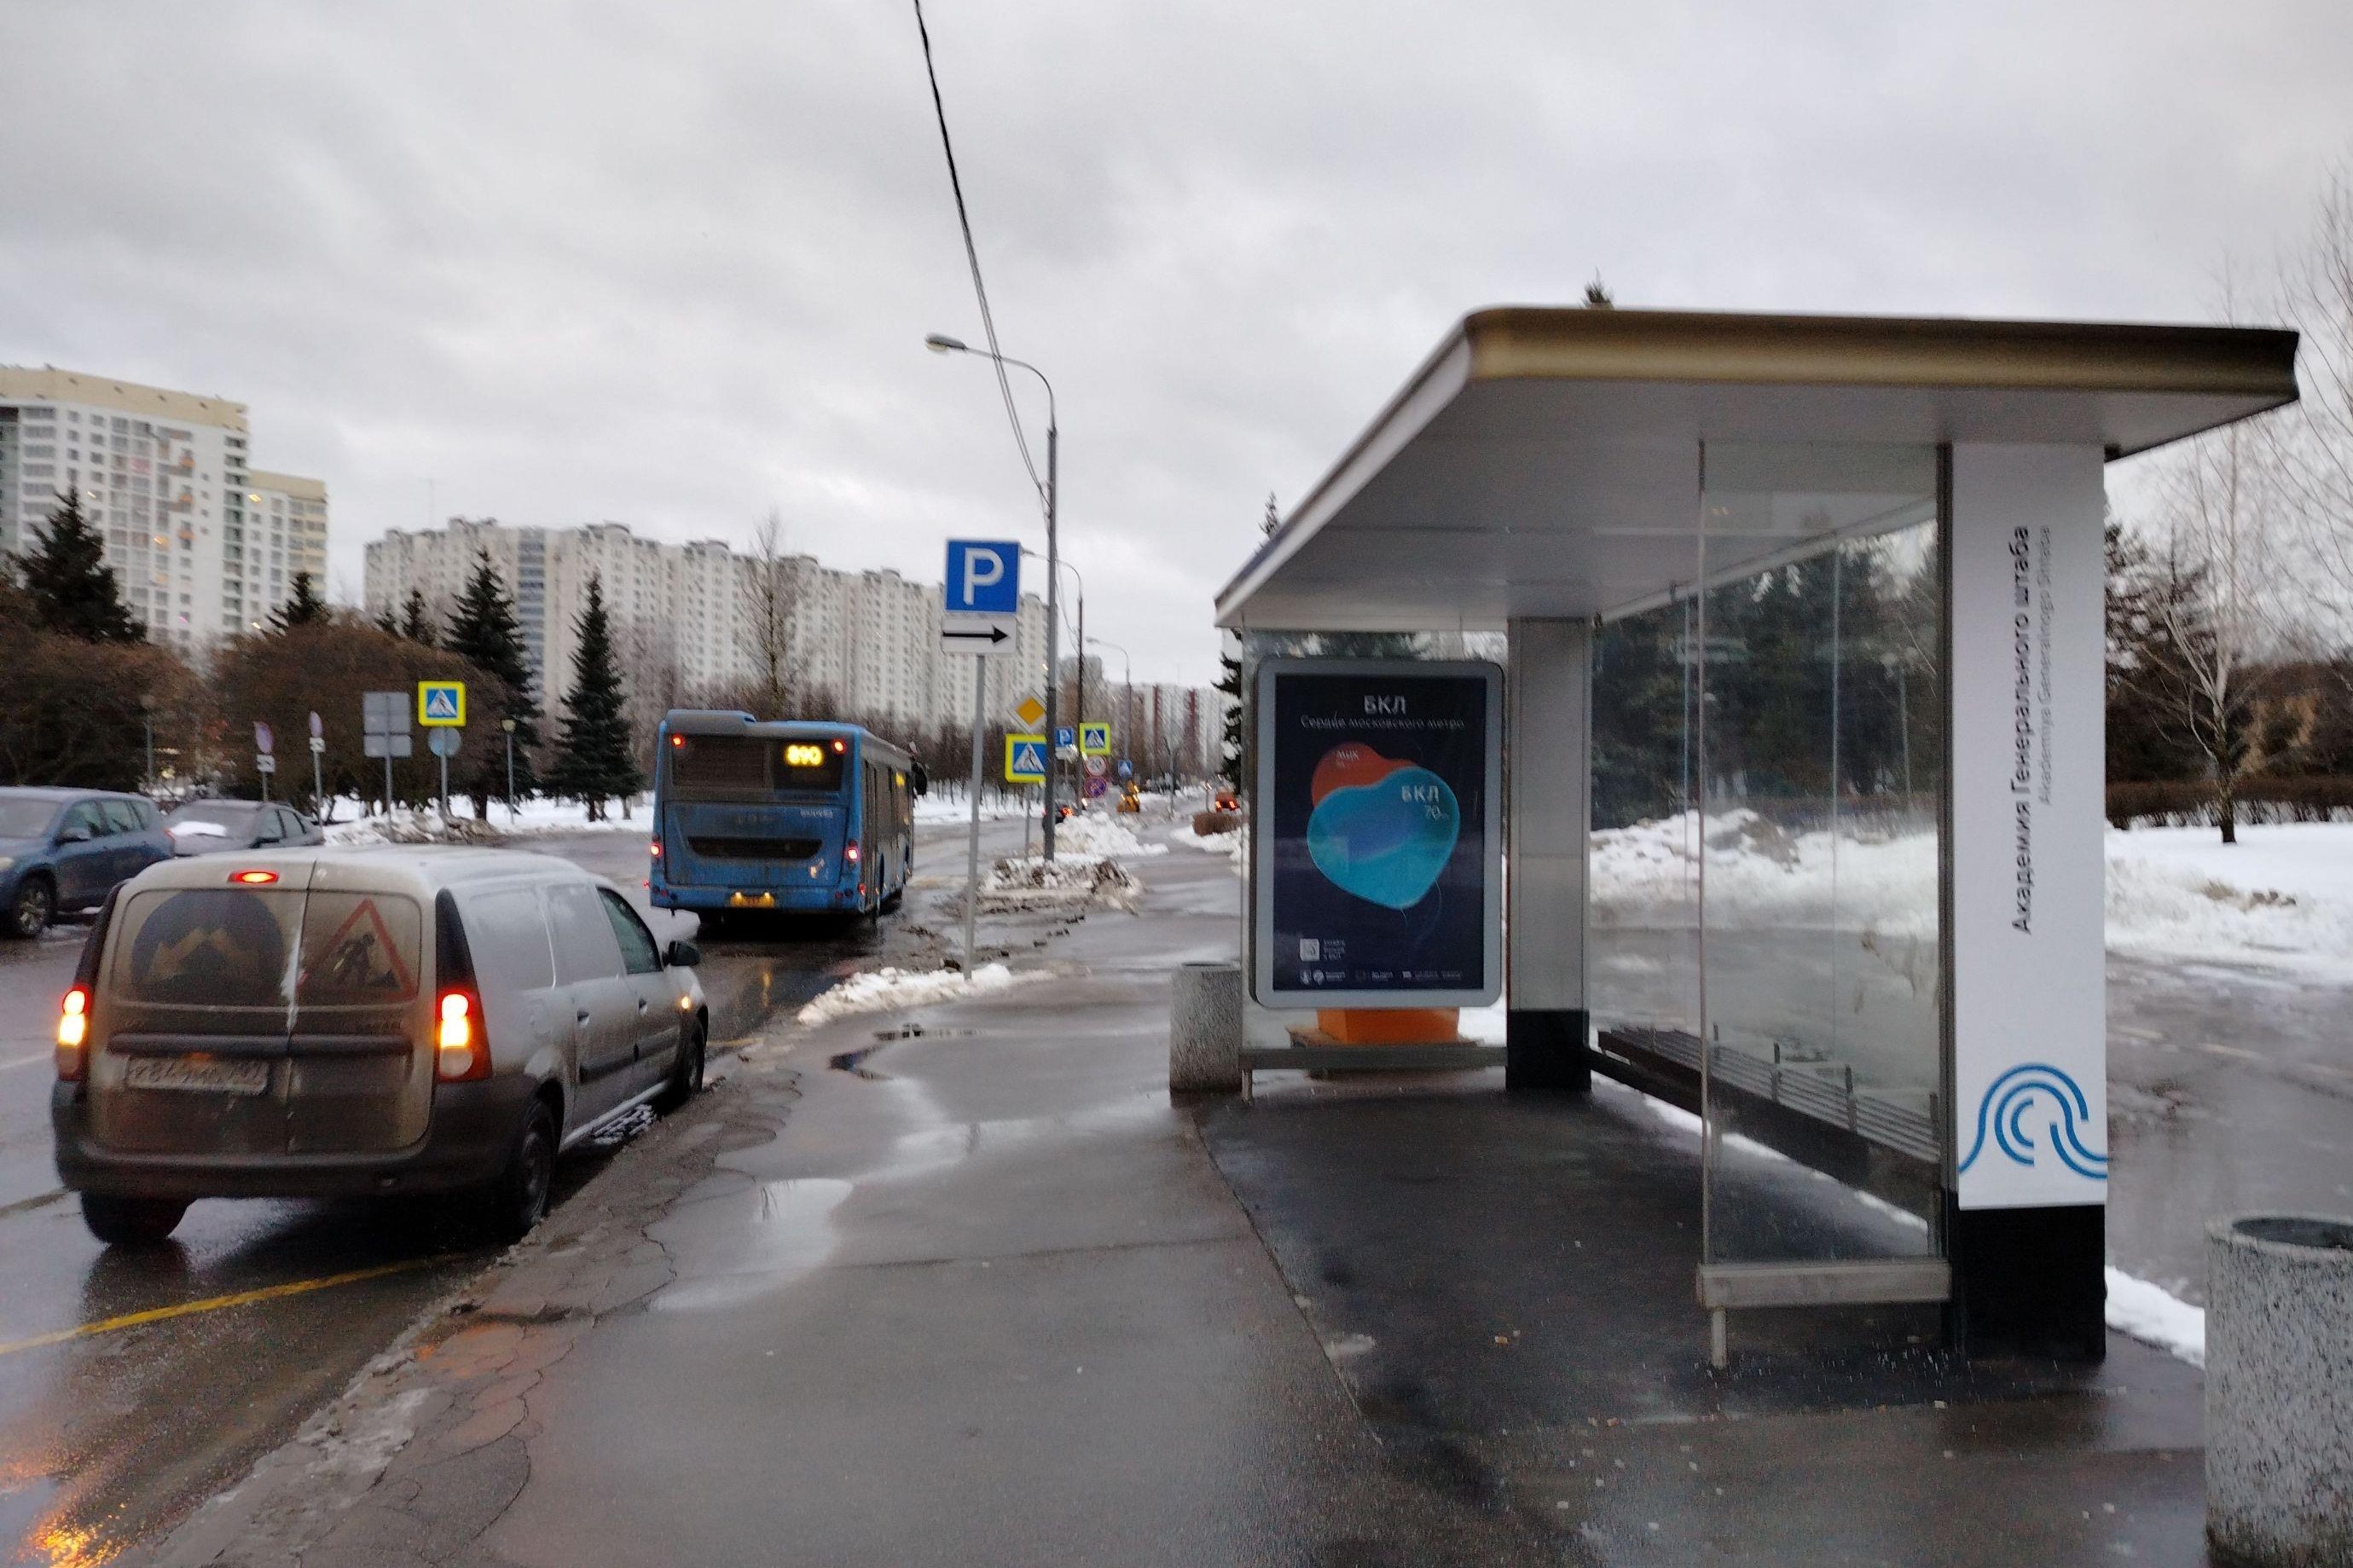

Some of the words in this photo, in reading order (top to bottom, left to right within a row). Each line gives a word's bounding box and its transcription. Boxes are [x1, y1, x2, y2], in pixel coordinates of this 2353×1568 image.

[963, 547, 1004, 606] P
[2008, 525, 2030, 608] штаба
[1365, 695, 1406, 715] БКЛ
[2010, 612, 2033, 795] Генерального
[1401, 784, 1440, 803] БКЛ
[2011, 800, 2033, 935] Академия
